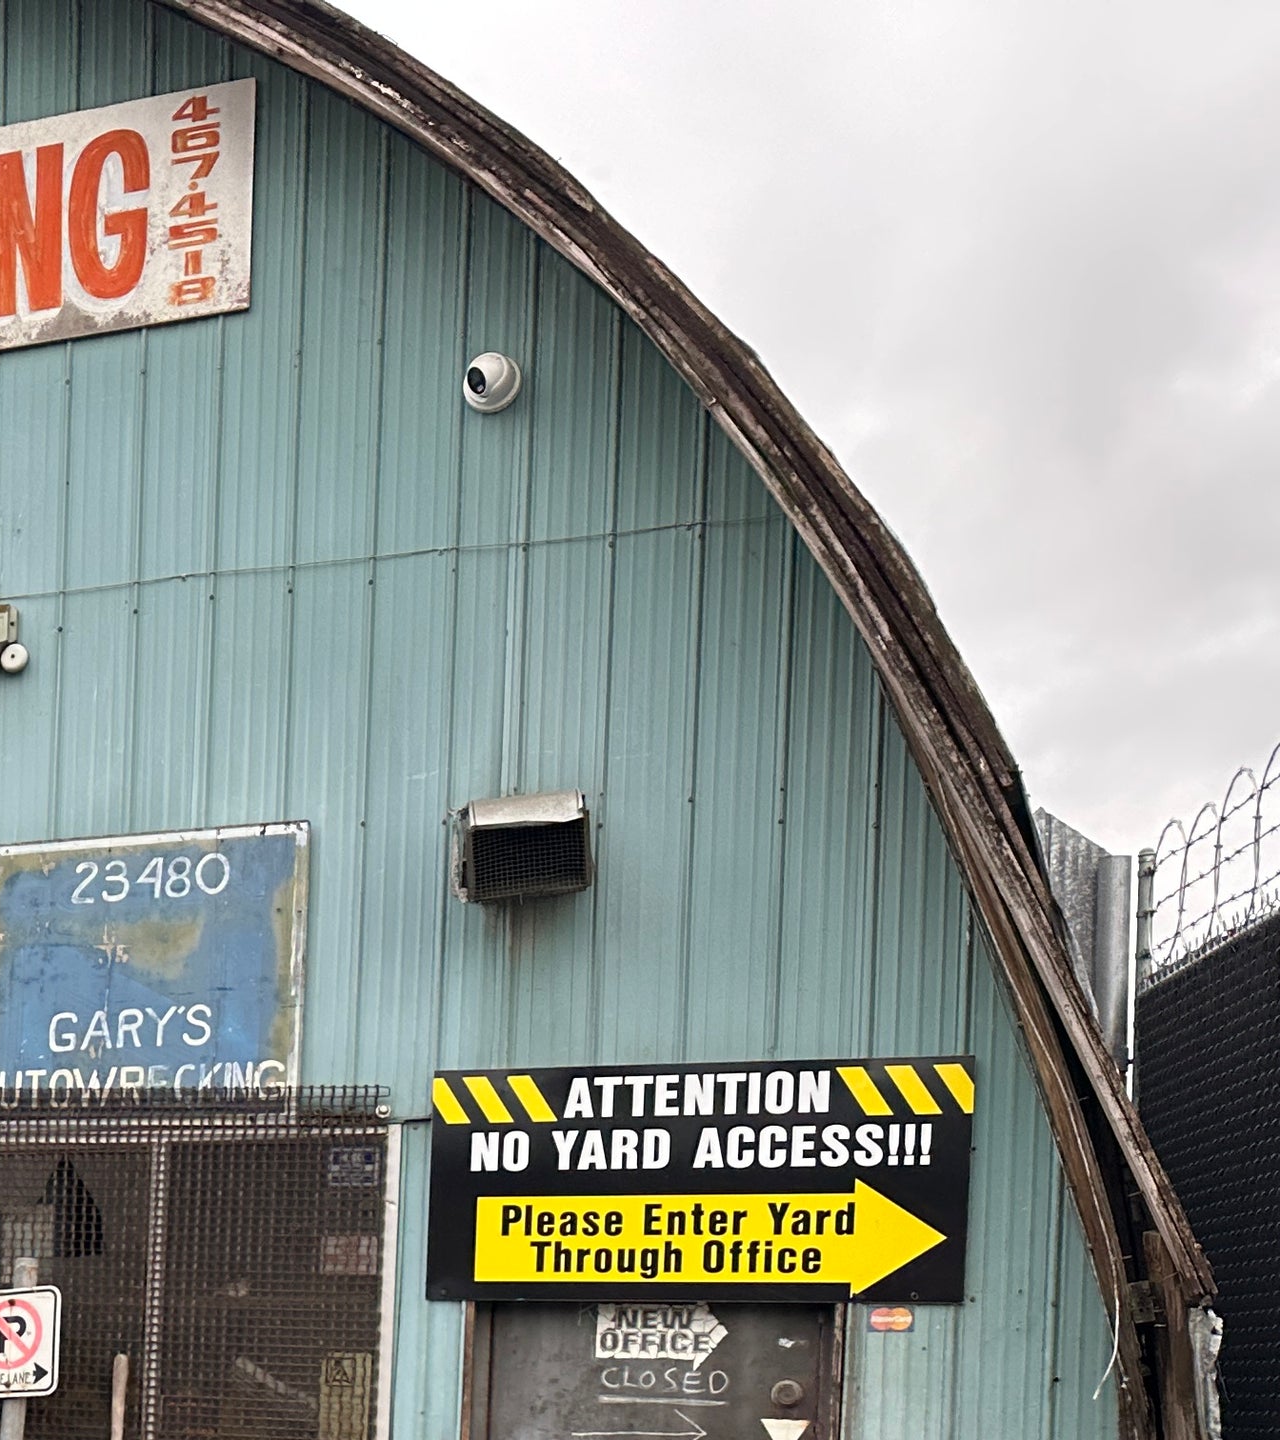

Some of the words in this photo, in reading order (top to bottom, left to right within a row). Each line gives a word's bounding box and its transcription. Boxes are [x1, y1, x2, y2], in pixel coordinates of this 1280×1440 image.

[71, 852, 231, 904] 23480
[48, 1004, 213, 1054] GARY'S
[563, 1070, 831, 1119] ATTENTION
[469, 1131, 530, 1172] NO
[553, 1128, 672, 1171] YARD
[693, 1123, 934, 1170] ACCESS!!!
[501, 1204, 623, 1237] Please
[643, 1203, 748, 1236] Enter
[768, 1202, 856, 1236] Yard
[530, 1241, 683, 1279] Through
[702, 1240, 822, 1274] Office
[616, 1307, 691, 1329] NEW
[600, 1330, 712, 1352] OFFICE
[601, 1366, 729, 1394] CLOSED
